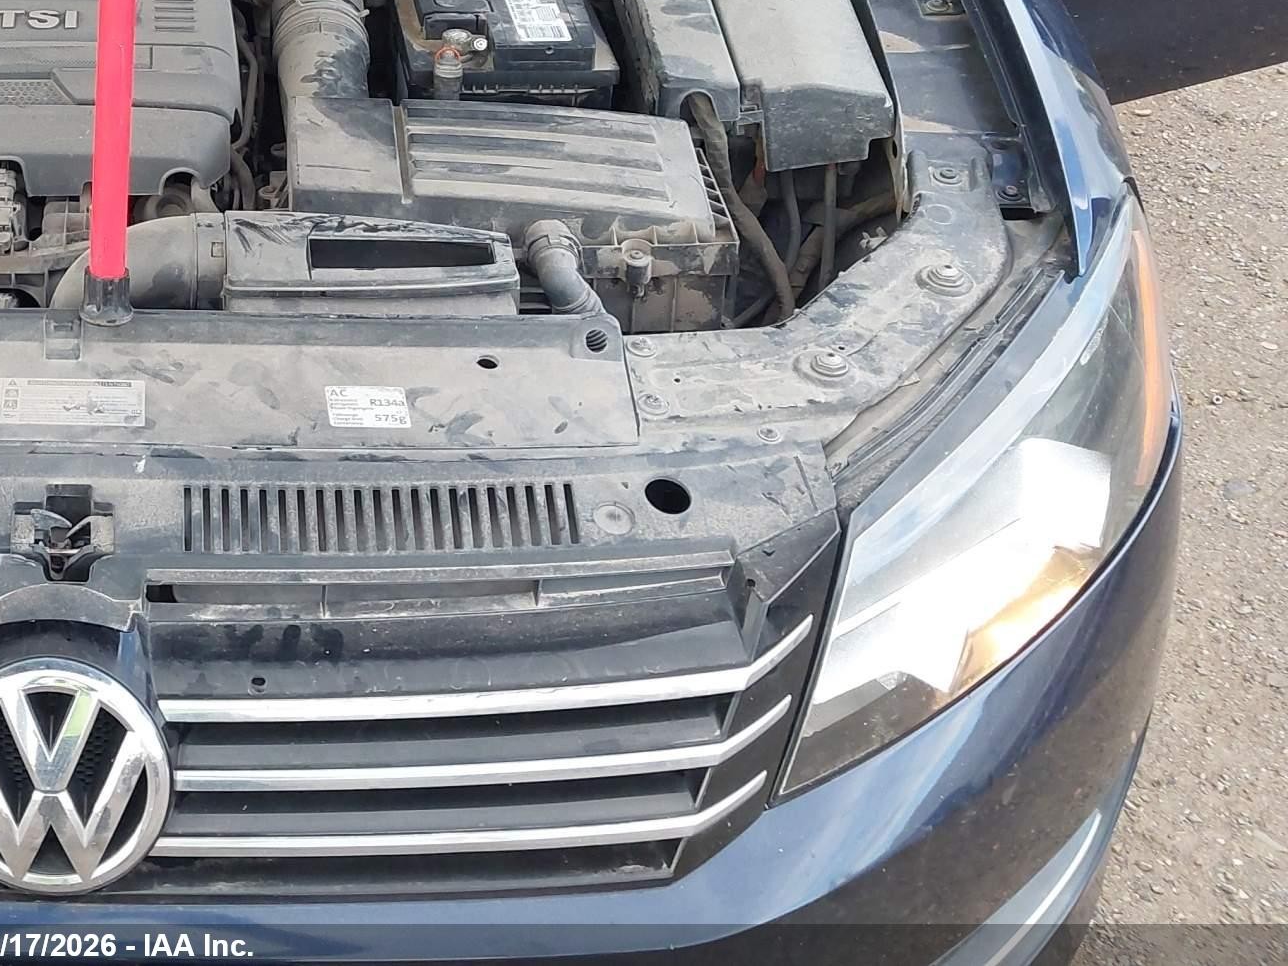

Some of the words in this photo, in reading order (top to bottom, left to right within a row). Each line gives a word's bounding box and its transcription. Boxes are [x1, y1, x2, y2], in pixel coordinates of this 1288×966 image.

[330, 388, 348, 397] AC
[369, 398, 405, 407] R134a
[375, 414, 407, 425] 575g
